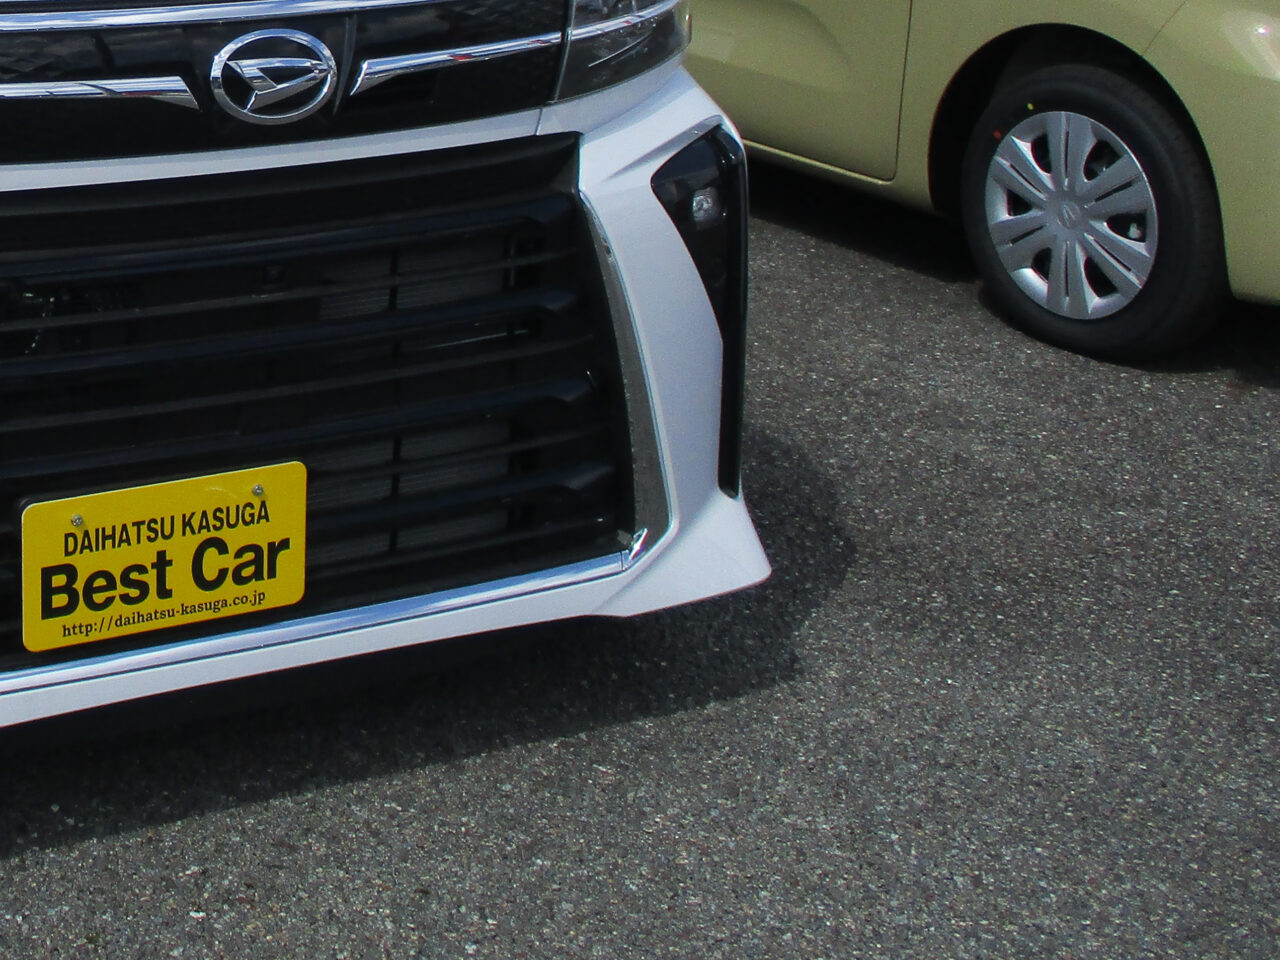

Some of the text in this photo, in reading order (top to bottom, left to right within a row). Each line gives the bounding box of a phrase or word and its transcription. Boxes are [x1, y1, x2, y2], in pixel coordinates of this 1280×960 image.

[64, 500, 270, 557] DAIHATSU KASUGA
[40, 536, 290, 620] Best Car
[62, 590, 266, 637] http://daihatsu-kasuga.co.jp
